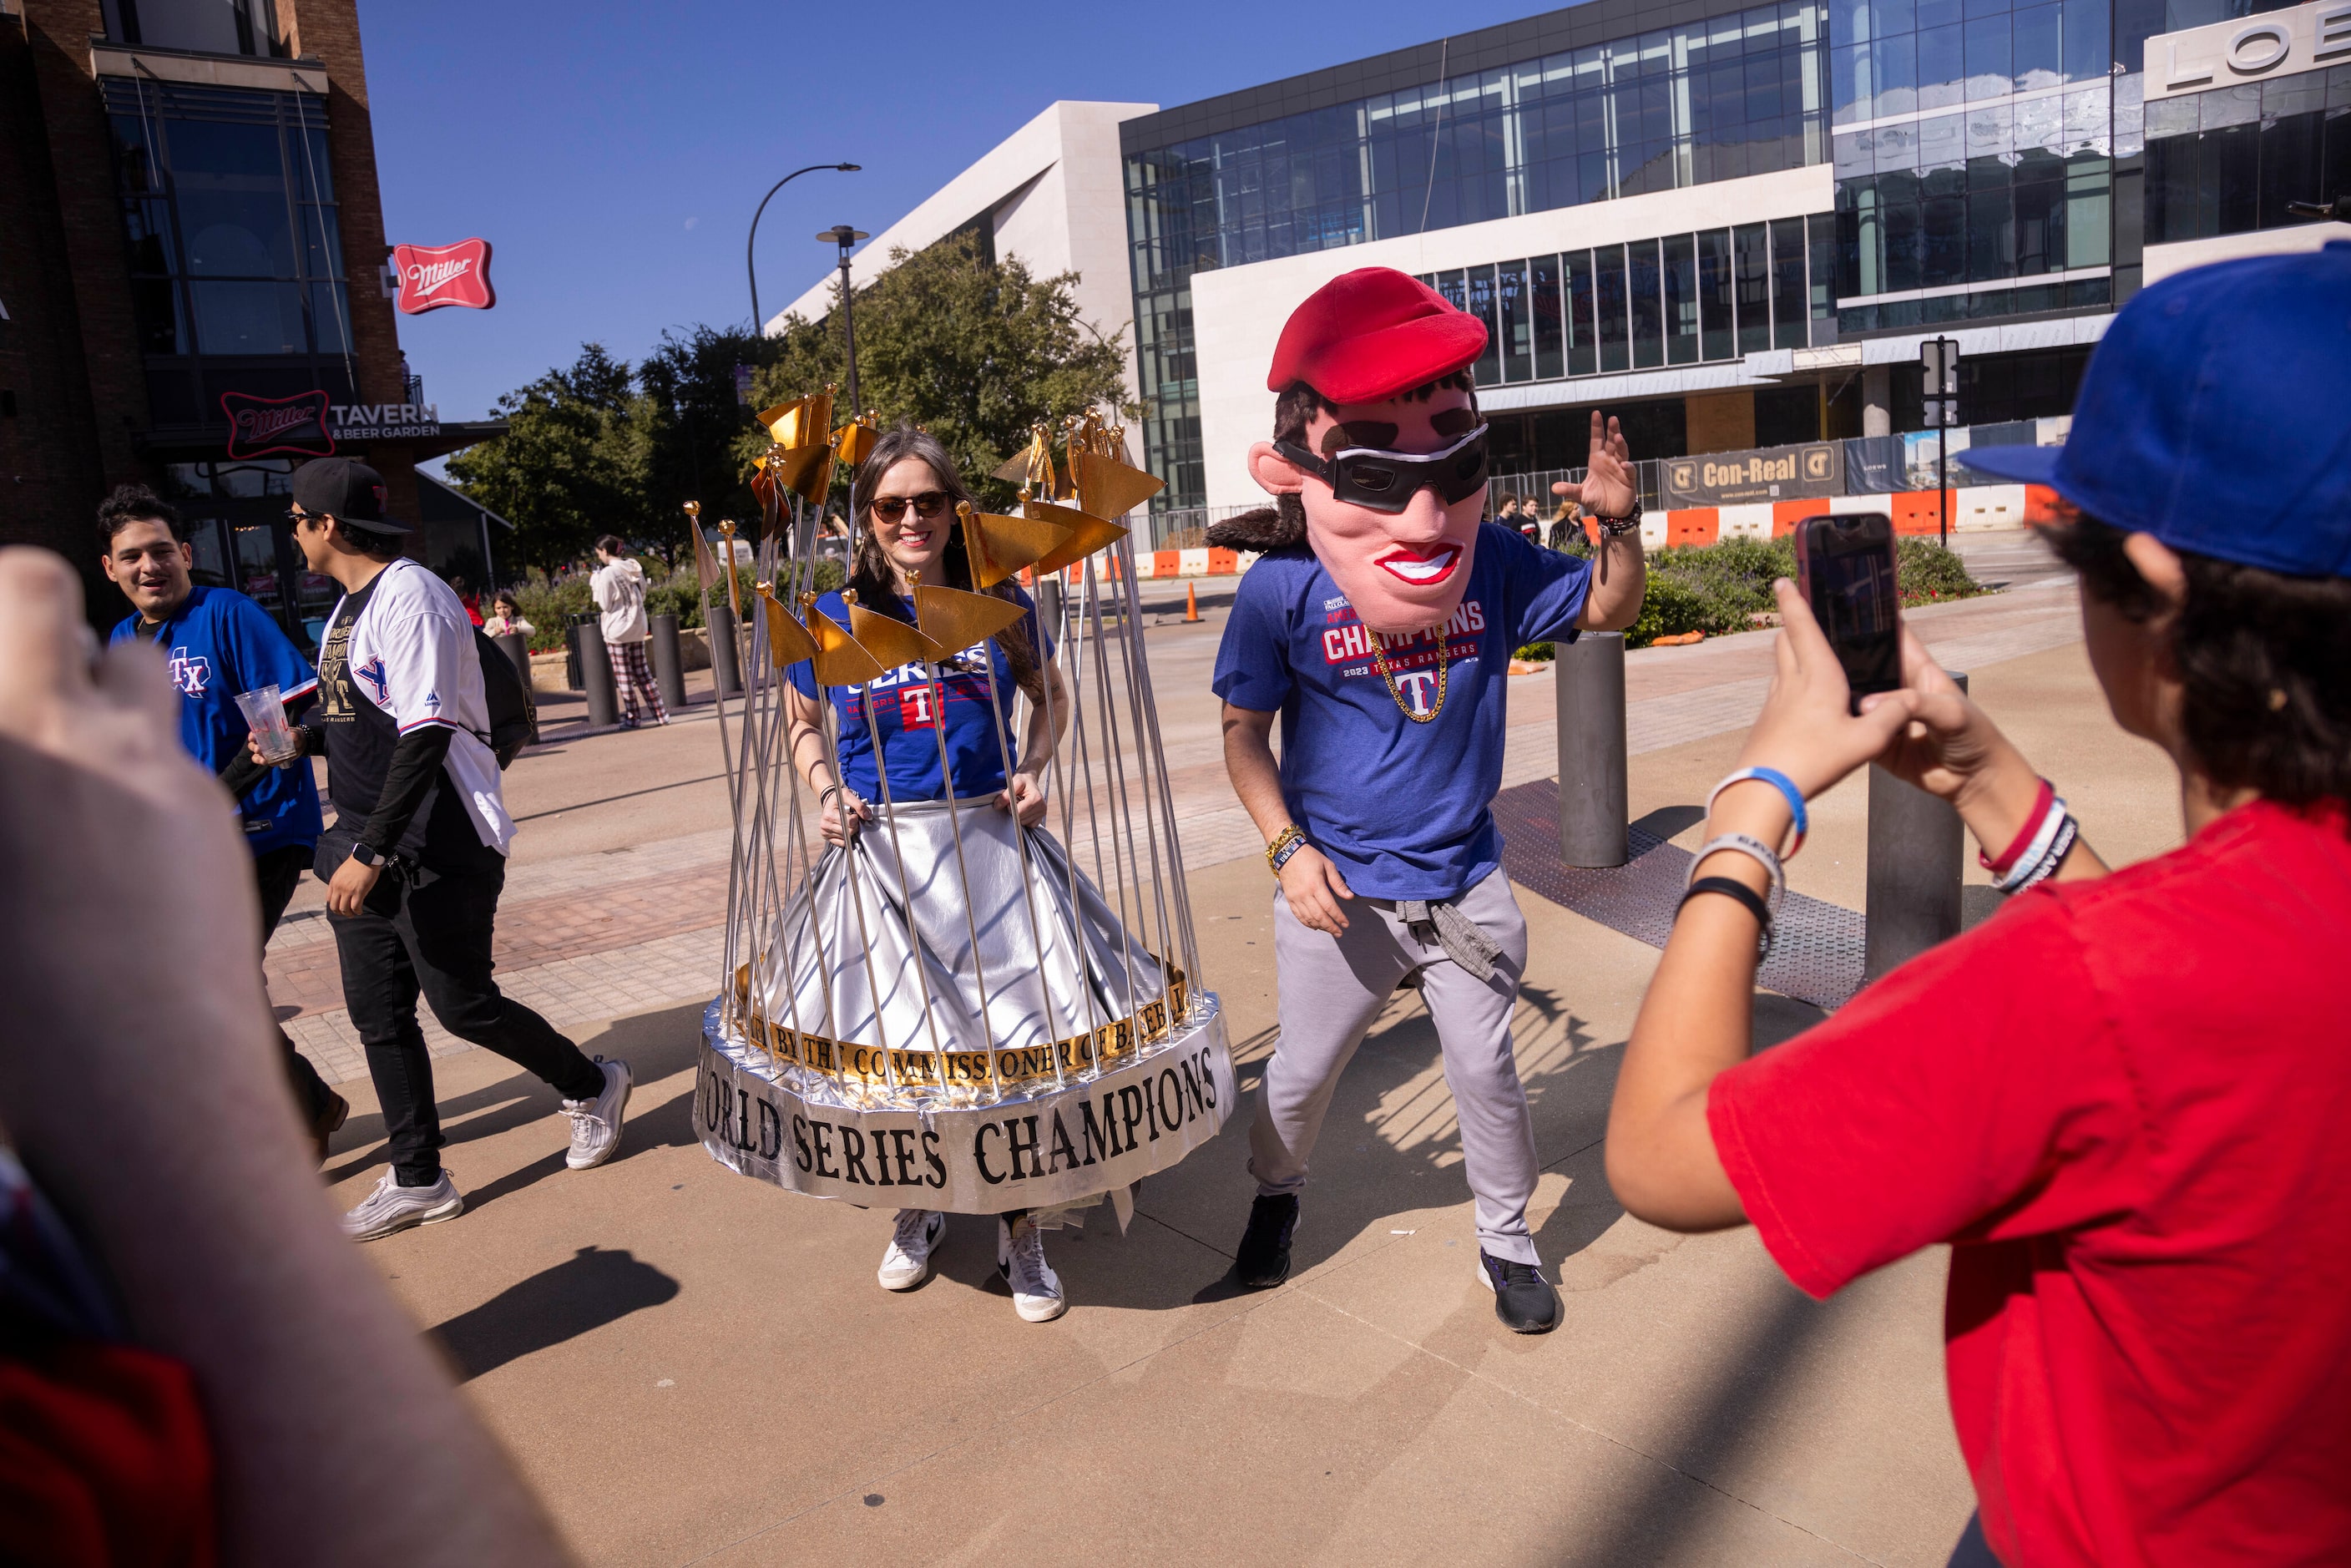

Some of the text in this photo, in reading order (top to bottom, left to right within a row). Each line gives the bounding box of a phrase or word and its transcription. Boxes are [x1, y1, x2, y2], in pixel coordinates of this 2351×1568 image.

[407, 259, 473, 294] Miller
[237, 406, 316, 438] Miller
[330, 403, 439, 426] TAVERN
[382, 426, 440, 438] GARDEN
[1703, 453, 1796, 488] Con-Real
[1342, 666, 1369, 678] 2023
[1373, 658, 1410, 673] TXAS
[846, 696, 896, 715] RAERS
[903, 687, 938, 722] T
[1394, 670, 1438, 716] T
[1279, 851, 1292, 863] USA
[1079, 1027, 1108, 1061] OF
[792, 1113, 947, 1189] SERIES
[973, 1045, 1217, 1186] CHAMPIONS
